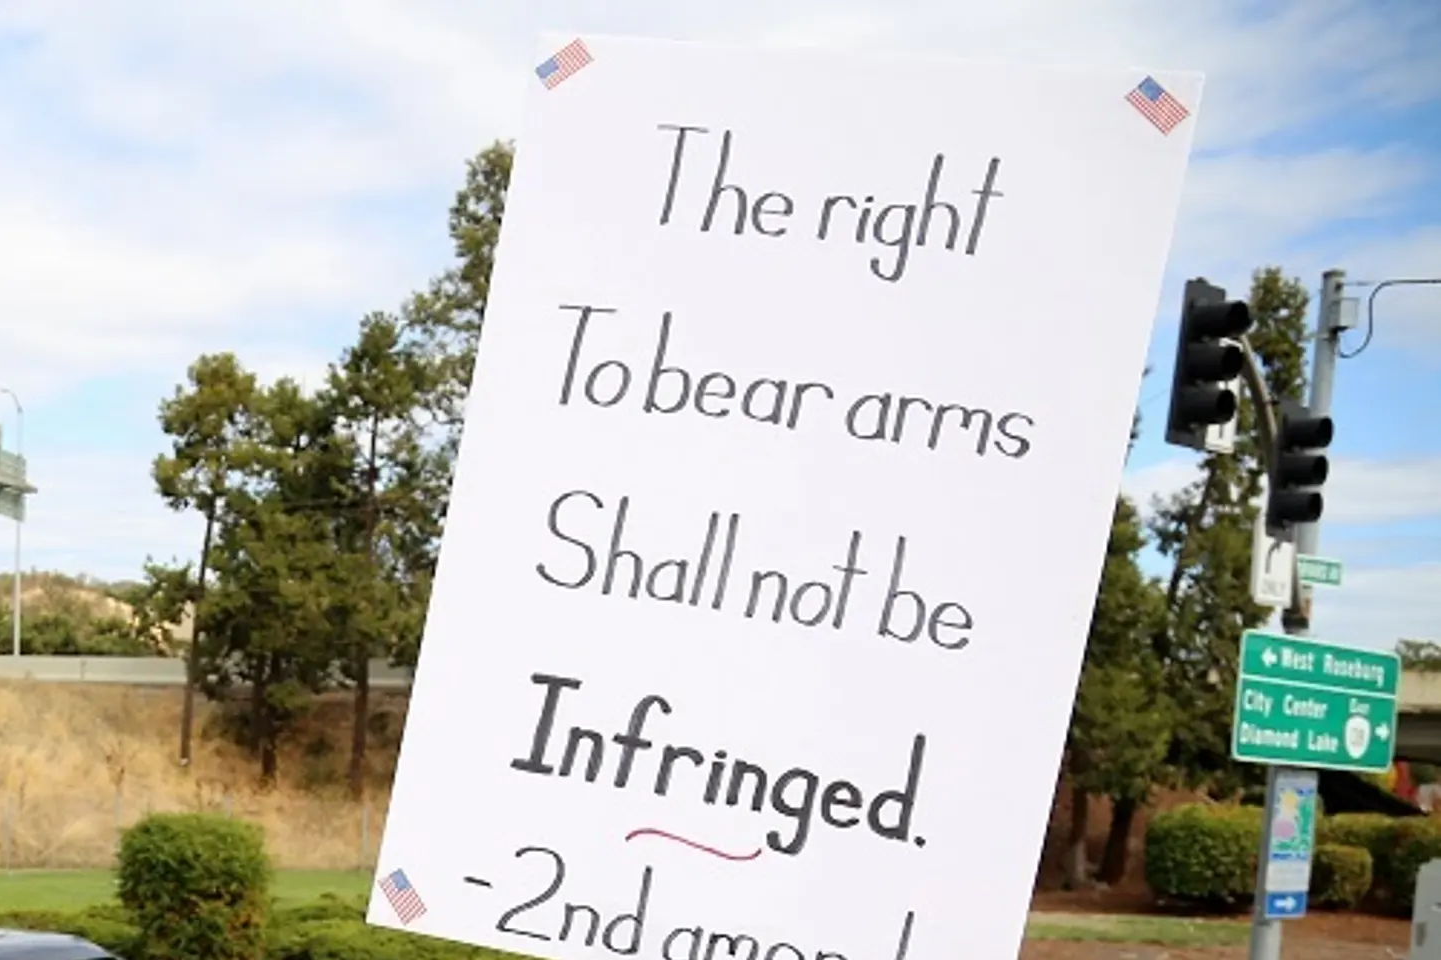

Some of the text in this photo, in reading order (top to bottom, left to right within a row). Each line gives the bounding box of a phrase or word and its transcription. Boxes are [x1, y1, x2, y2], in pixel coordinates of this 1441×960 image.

[657, 123, 1004, 285] The right
[558, 303, 1035, 461] To bear arms
[535, 489, 974, 651] Shall not be
[1239, 720, 1339, 754] Diamond Lake
[1242, 688, 1328, 719] City Center
[1280, 647, 1385, 689] West Roseburg
[509, 672, 927, 857] Infringed.
